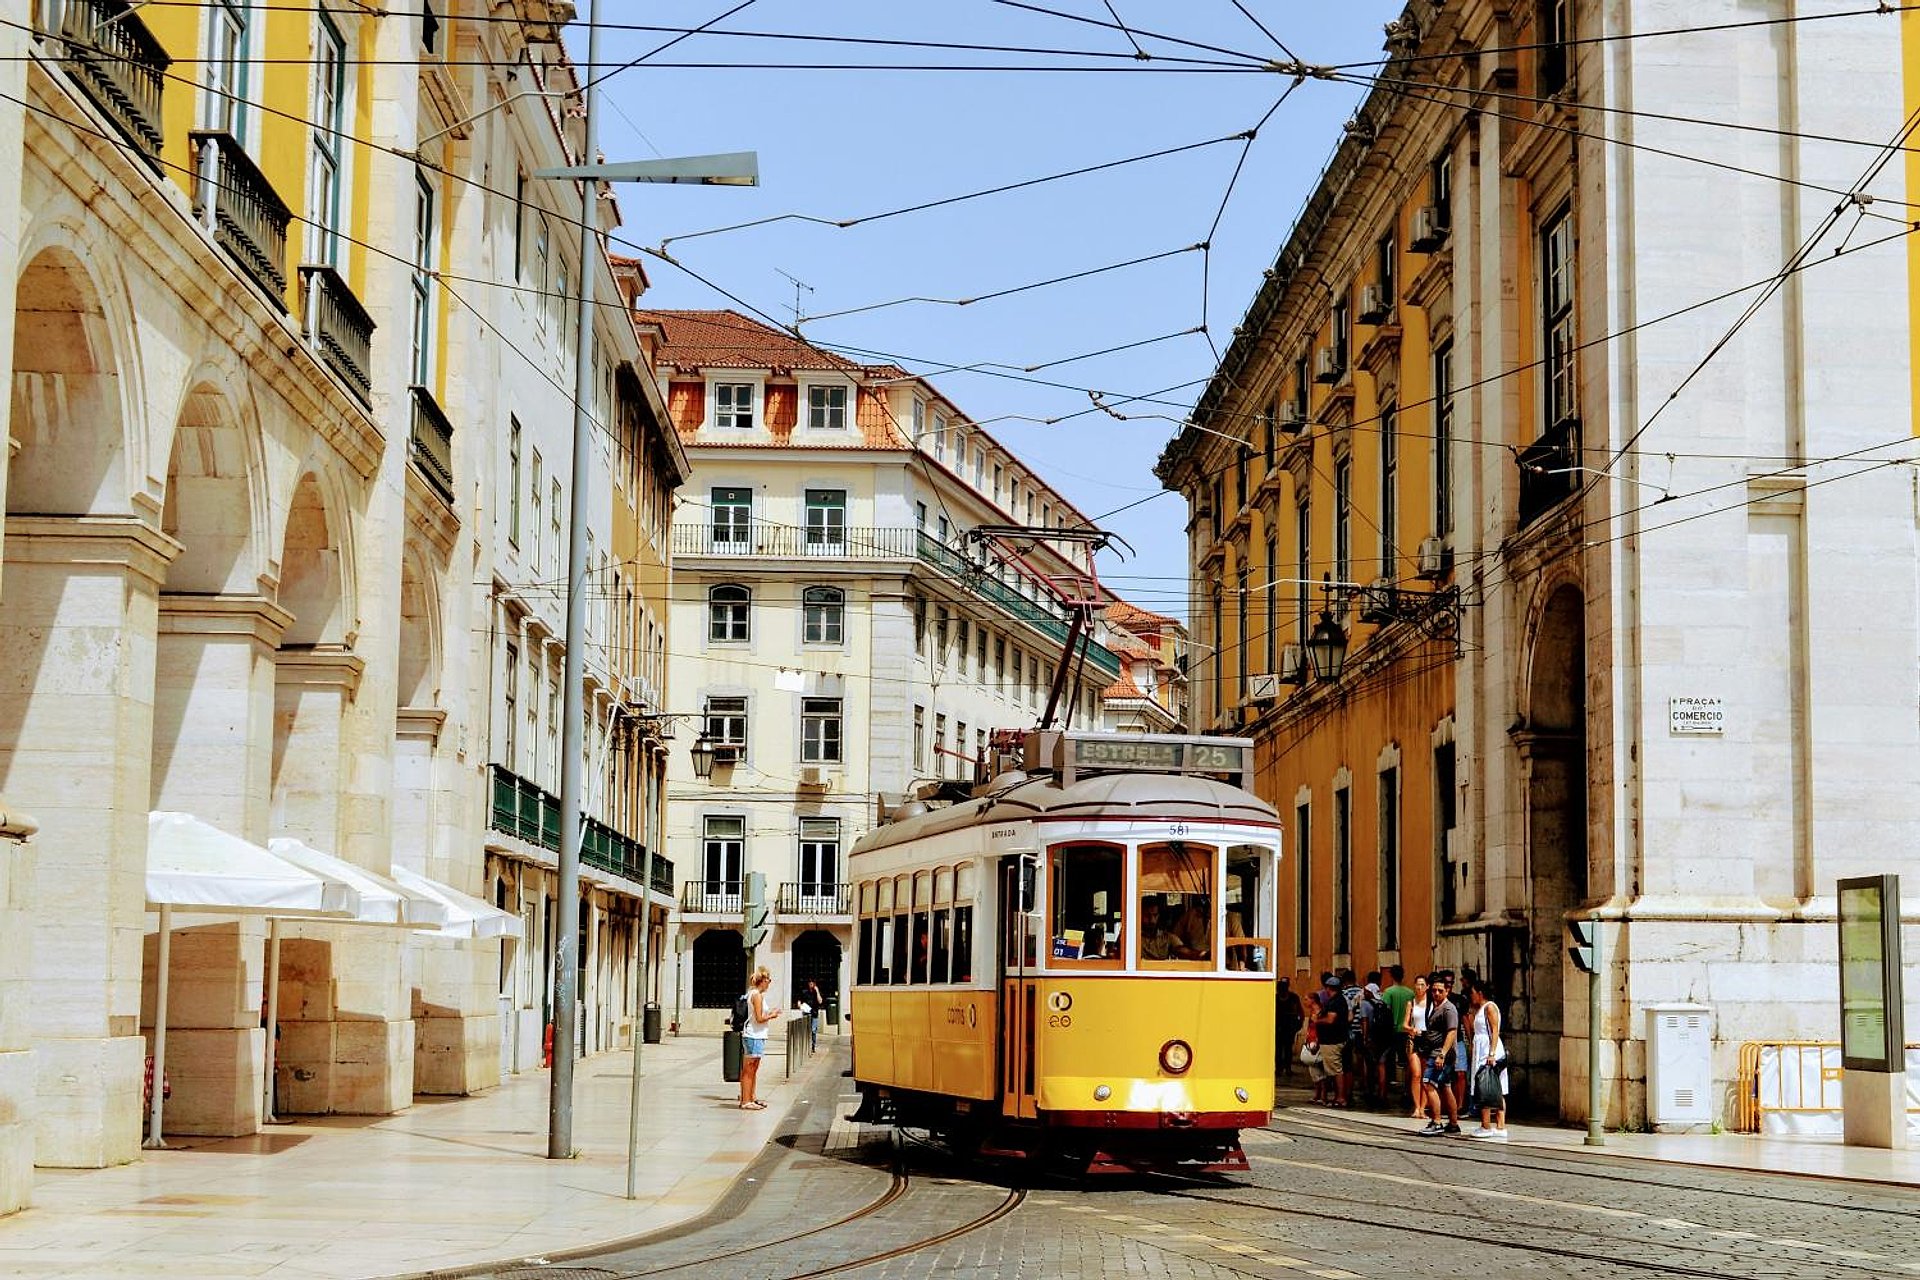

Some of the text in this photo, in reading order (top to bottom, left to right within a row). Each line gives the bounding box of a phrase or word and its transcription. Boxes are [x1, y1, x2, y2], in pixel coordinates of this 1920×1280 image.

[1679, 697, 1715, 707] PRAÇA
[1672, 711, 1723, 721] COMERCIO
[1082, 742, 1227, 767] ESTRELA 25
[1169, 825, 1189, 836] 581
